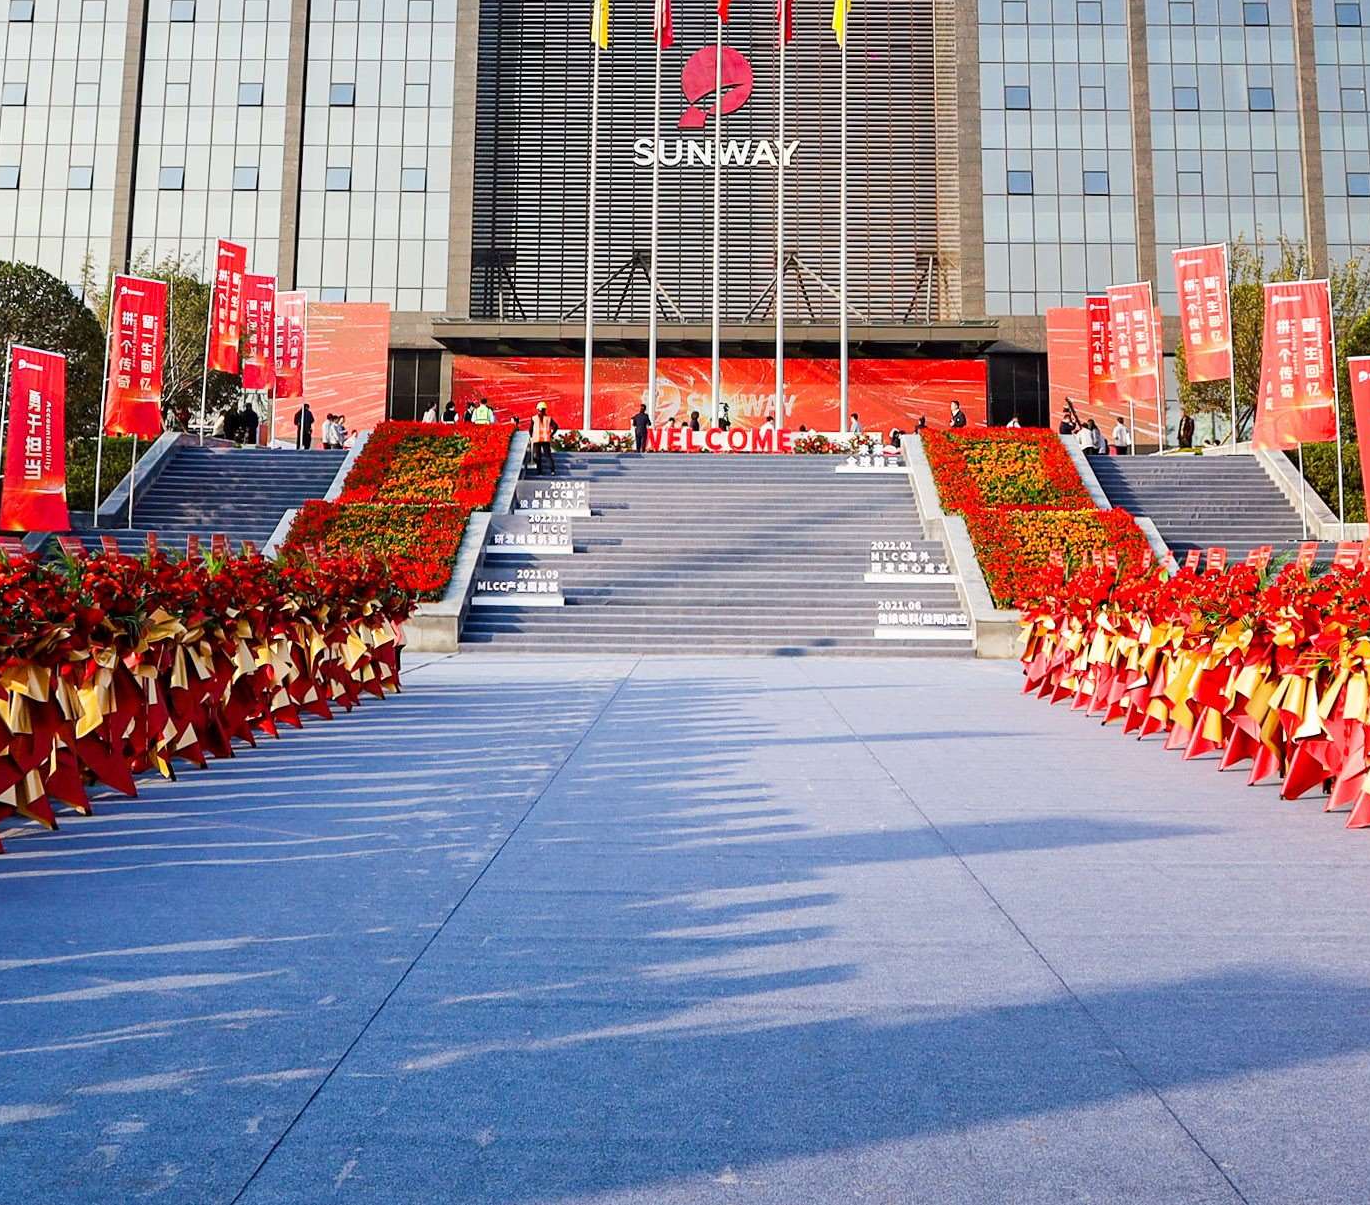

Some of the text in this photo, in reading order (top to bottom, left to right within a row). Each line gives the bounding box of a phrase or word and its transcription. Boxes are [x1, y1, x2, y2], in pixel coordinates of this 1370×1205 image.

[633, 138, 800, 167] SUNWAY
[117, 311, 135, 389] 拼一个传奇
[1276, 318, 1295, 399] 拼一个传奇
[1301, 316, 1321, 397] 留一生回忆
[23, 388, 43, 481] 勇于担当
[43, 400, 52, 471] Accountability
[647, 427, 792, 453] WELCOME
[531, 524, 567, 533] MLCC
[871, 541, 912, 551] 2022.02
[517, 569, 559, 579] 2021.09
[878, 600, 922, 611] 2021.06
